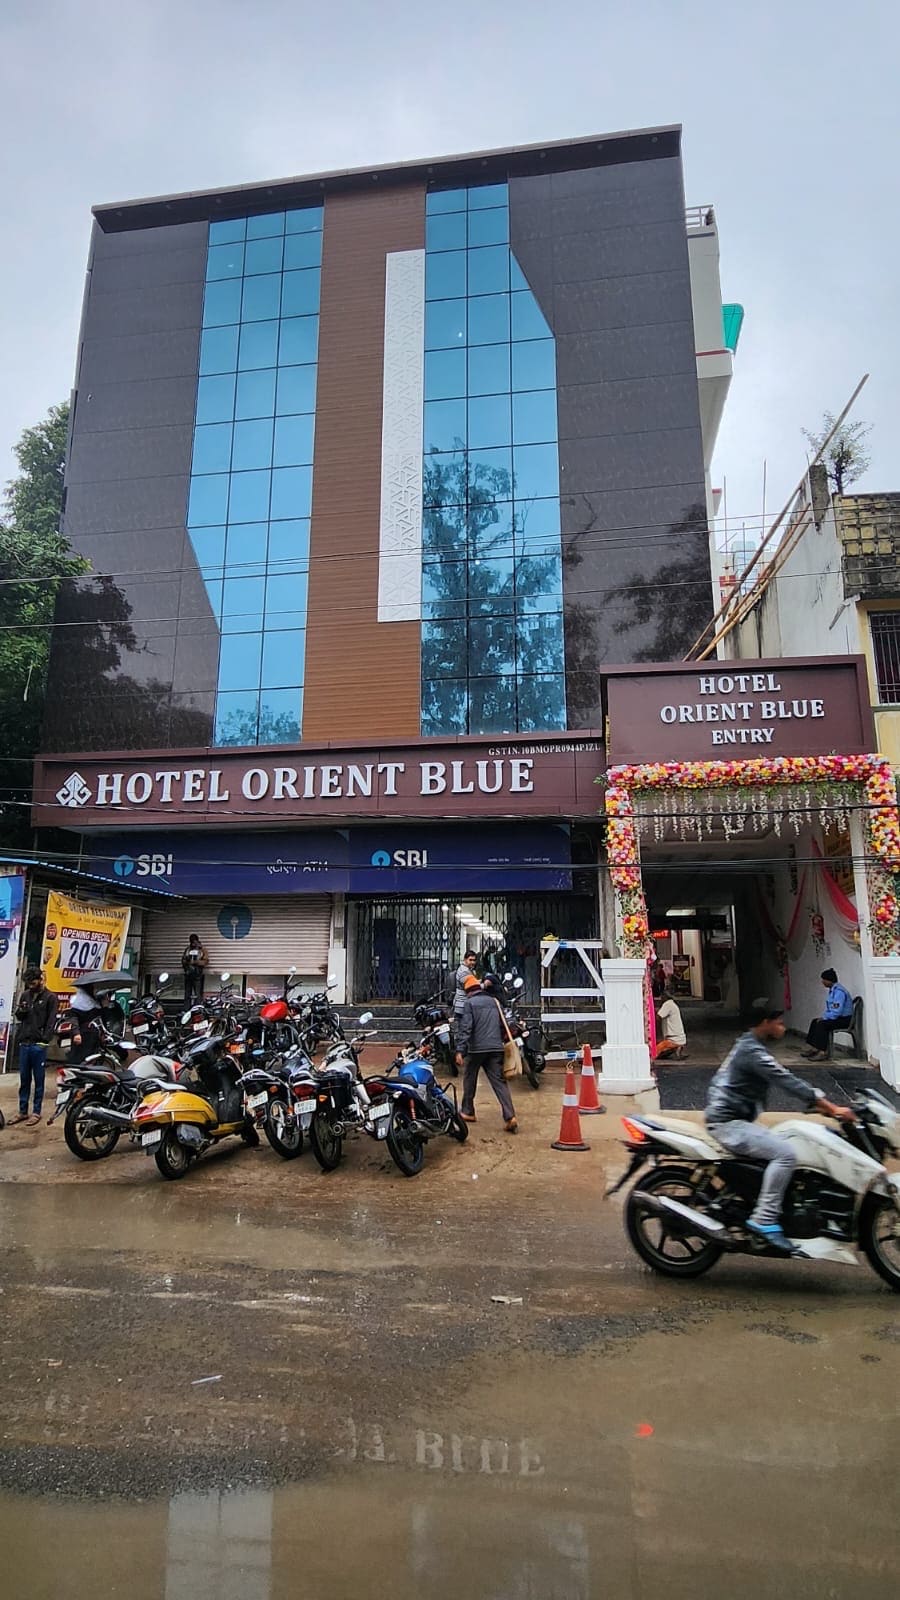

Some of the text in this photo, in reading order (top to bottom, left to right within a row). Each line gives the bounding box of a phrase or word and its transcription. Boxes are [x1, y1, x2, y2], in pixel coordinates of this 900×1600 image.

[699, 673, 781, 695] HOTEL
[660, 699, 825, 724] ORIENT BLUE
[712, 728, 775, 745] ENTRY
[95, 758, 534, 805] HOTEL ORIENT BLUE
[137, 854, 173, 875] SBI
[394, 850, 428, 868] SBI
[62, 928, 91, 940] OPENING
[68, 940, 102, 969] 20%
